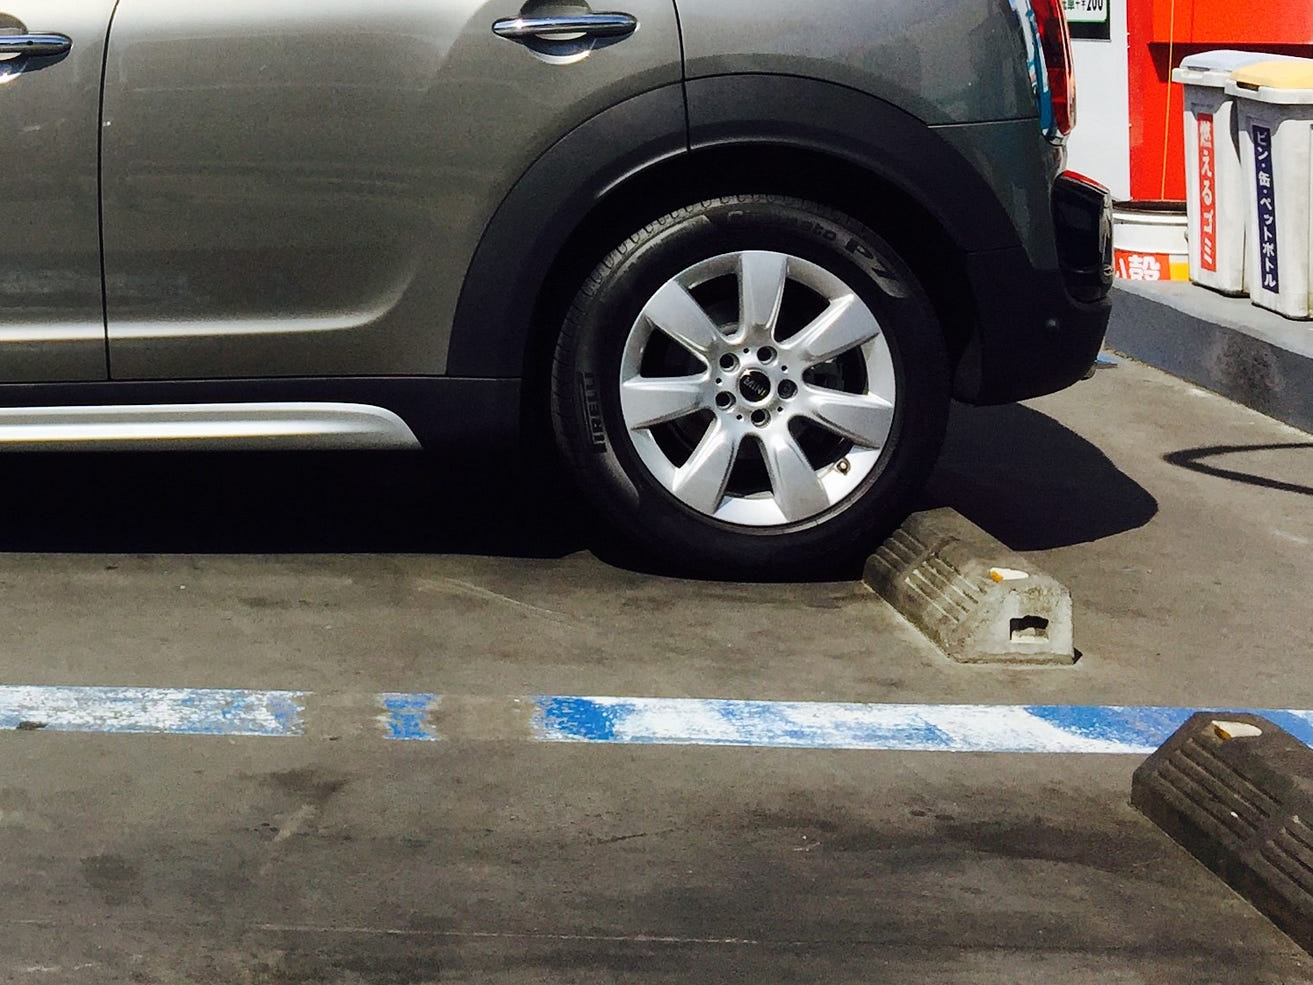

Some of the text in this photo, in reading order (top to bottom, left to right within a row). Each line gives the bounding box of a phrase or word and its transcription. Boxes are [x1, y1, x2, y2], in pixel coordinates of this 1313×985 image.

[1199, 121, 1215, 265] 燃えるゴミ
